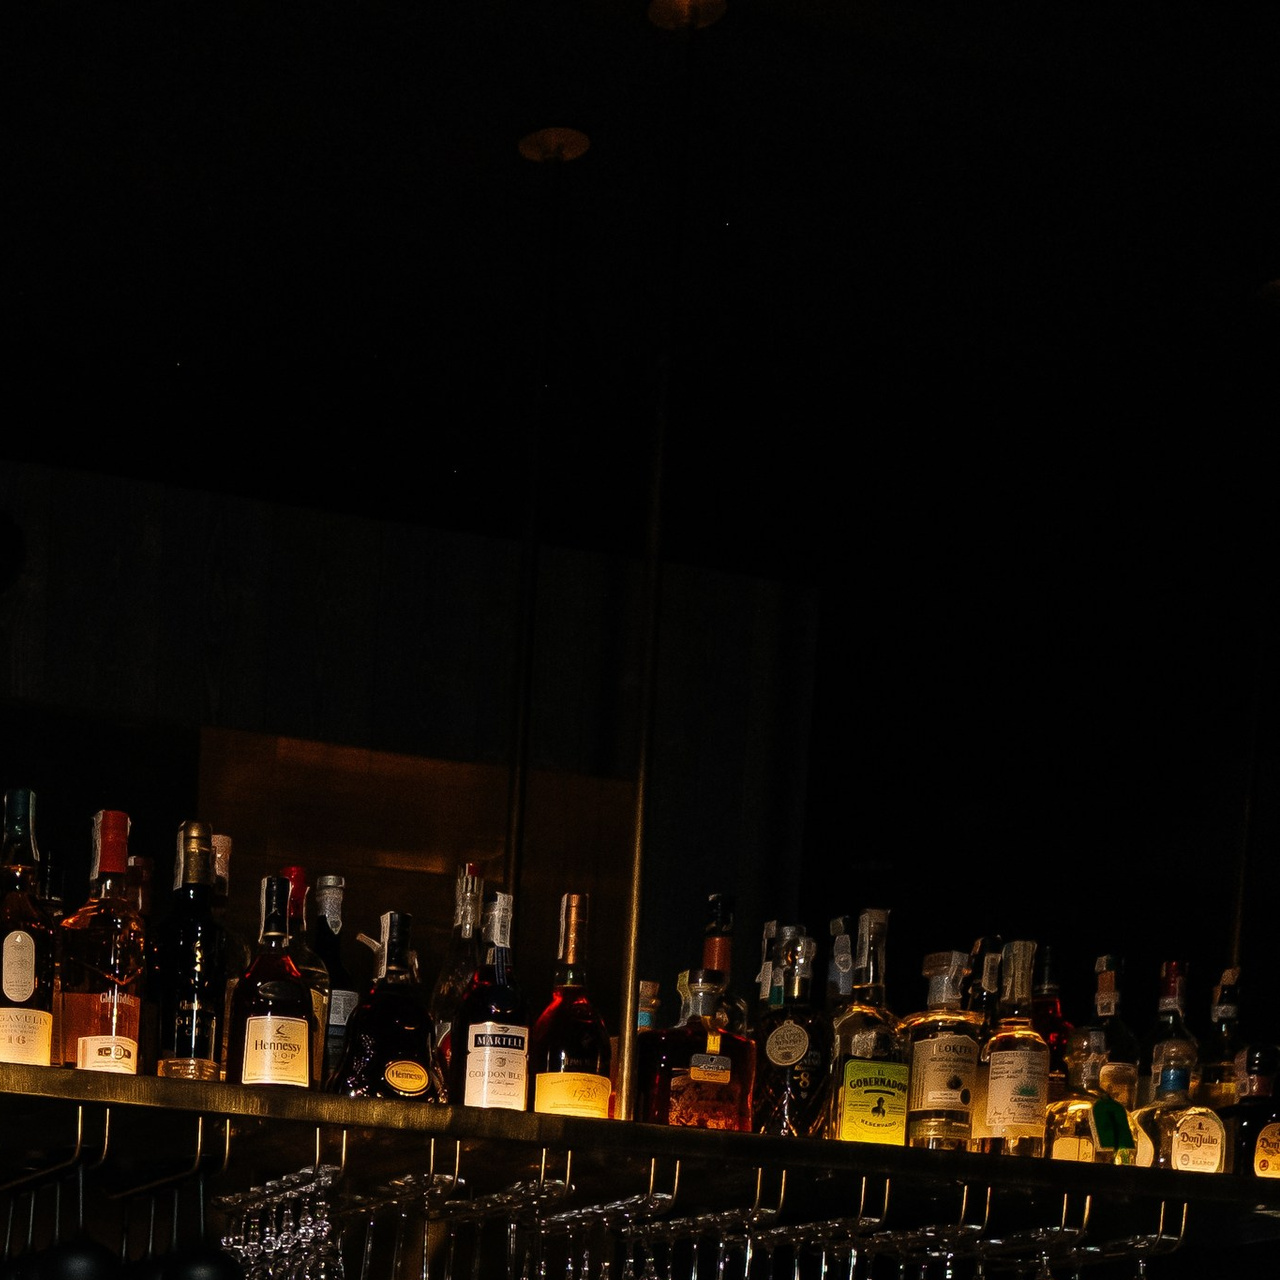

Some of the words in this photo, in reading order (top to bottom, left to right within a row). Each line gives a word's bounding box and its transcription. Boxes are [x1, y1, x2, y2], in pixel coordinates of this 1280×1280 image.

[7, 1035, 27, 1045] 16
[477, 1036, 522, 1047] MARTELL
[255, 1040, 301, 1054] Hennessy
[391, 1070, 424, 1081] Hennessy
[468, 1070, 506, 1078] CORDON
[849, 1077, 907, 1093] GOBERNADOR
[573, 1087, 599, 1102] 1738
[860, 1118, 897, 1128] RESERVADO
[1180, 1132, 1198, 1144] Don
[1195, 1133, 1218, 1147] Julio
